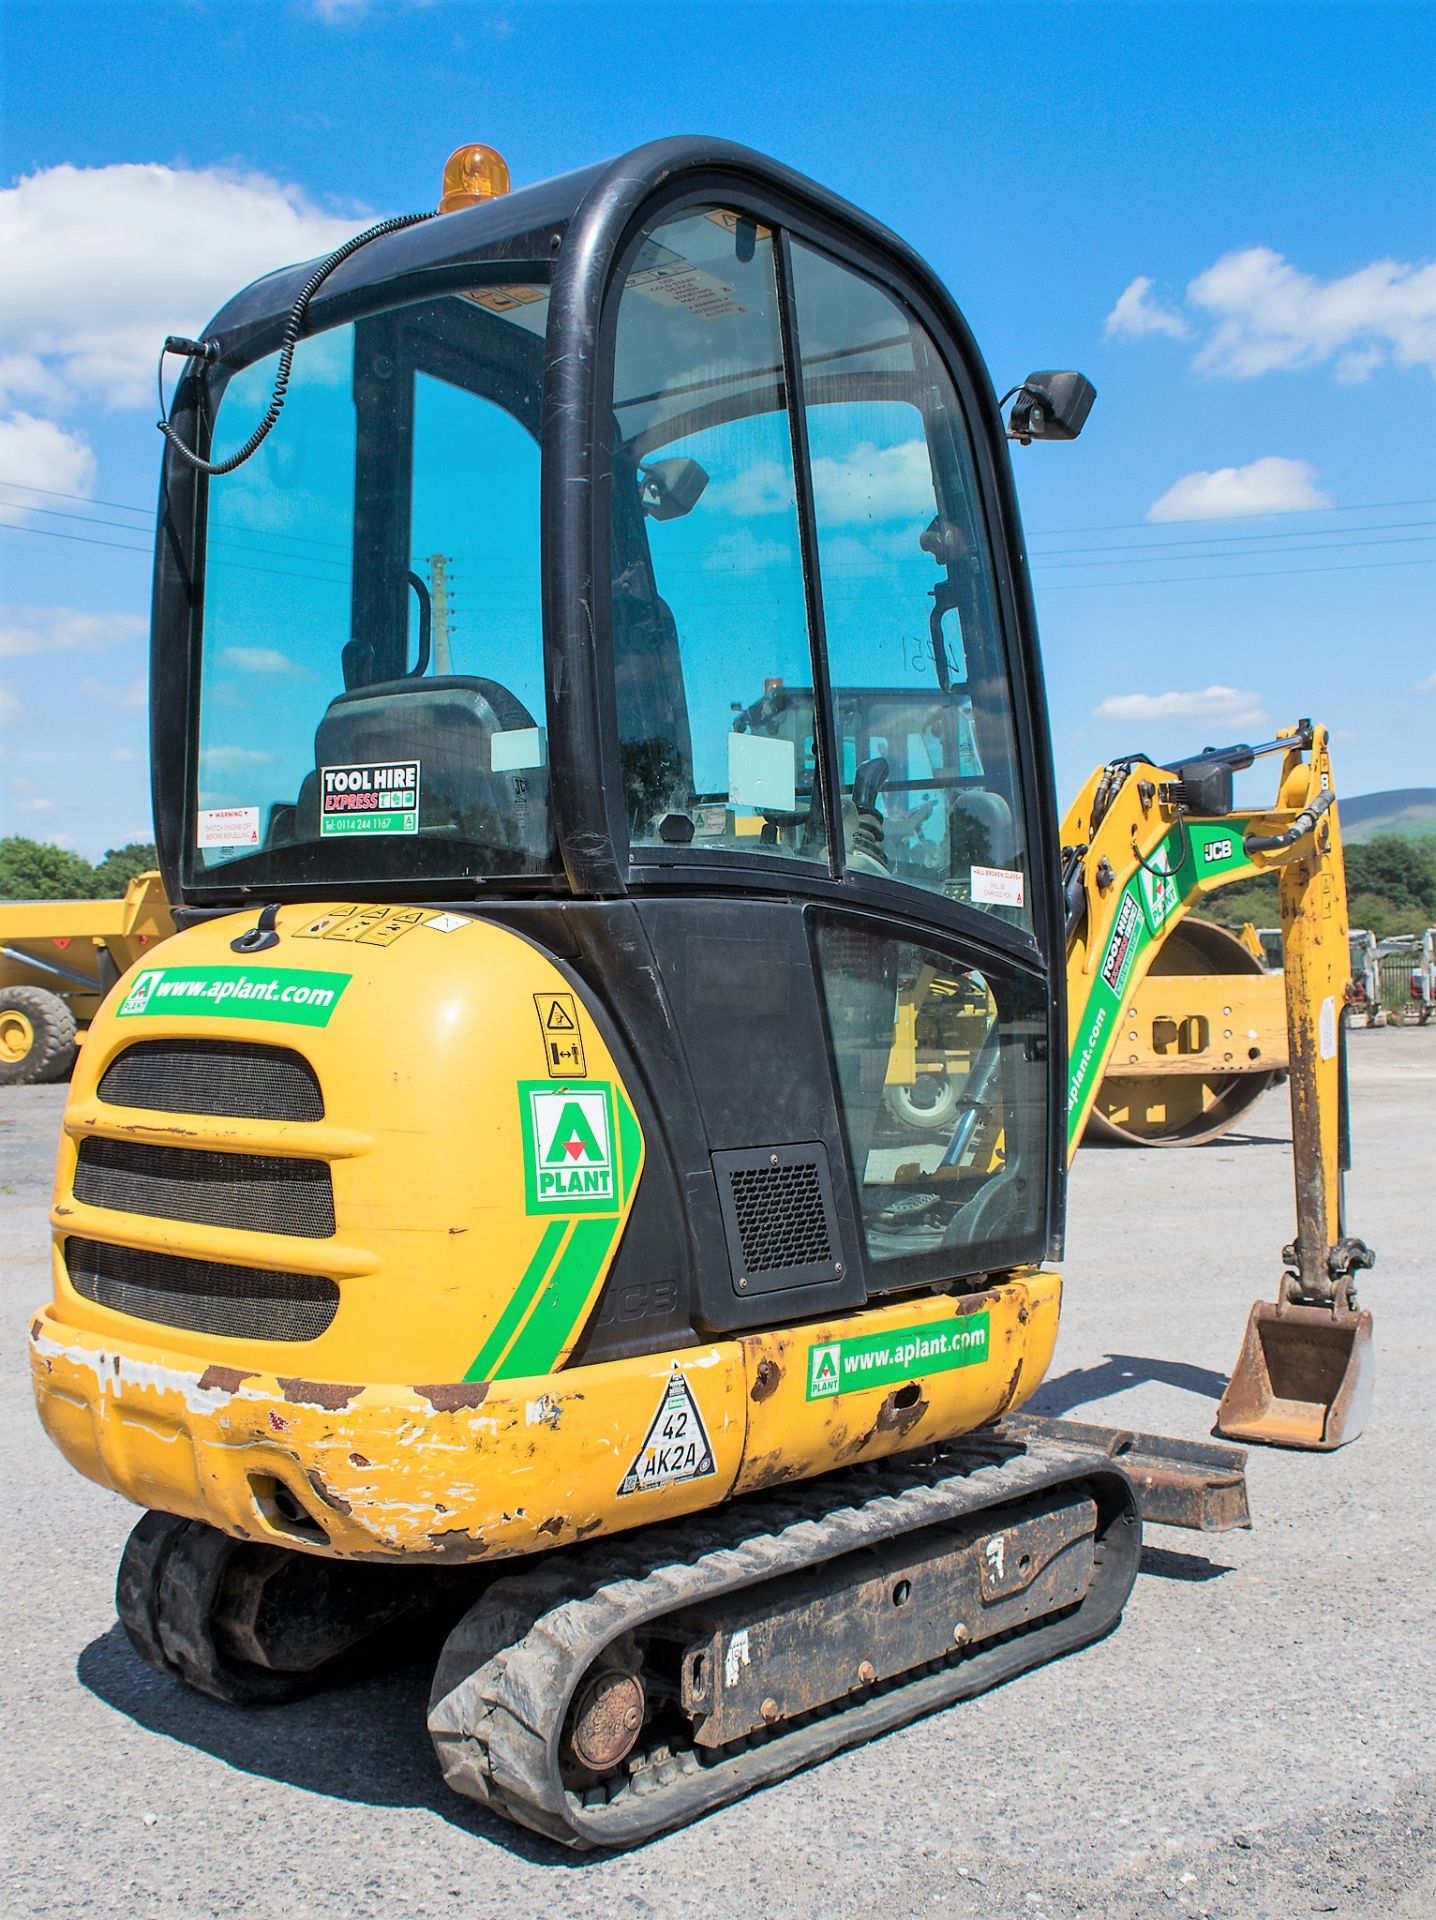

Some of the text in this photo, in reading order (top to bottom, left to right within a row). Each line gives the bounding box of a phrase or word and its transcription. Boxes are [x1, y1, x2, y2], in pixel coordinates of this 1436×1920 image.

[325, 767, 416, 792] TOOL HIRE
[324, 792, 379, 811] EXPRESS
[336, 819, 355, 830] 0114
[356, 818, 371, 830] 244
[373, 817, 392, 829] 1167
[1204, 839, 1232, 863] JCB
[1103, 896, 1134, 979] TOOL HIRE
[156, 976, 335, 1007] www.aplant.com
[545, 1102, 606, 1162] A
[540, 1170, 610, 1194] PLANT
[844, 1328, 986, 1373] www.aplant.com
[815, 1351, 837, 1380] A
[812, 1380, 838, 1393] PLANT
[662, 1412, 688, 1440] 42
[643, 1442, 696, 1478] AK2A
